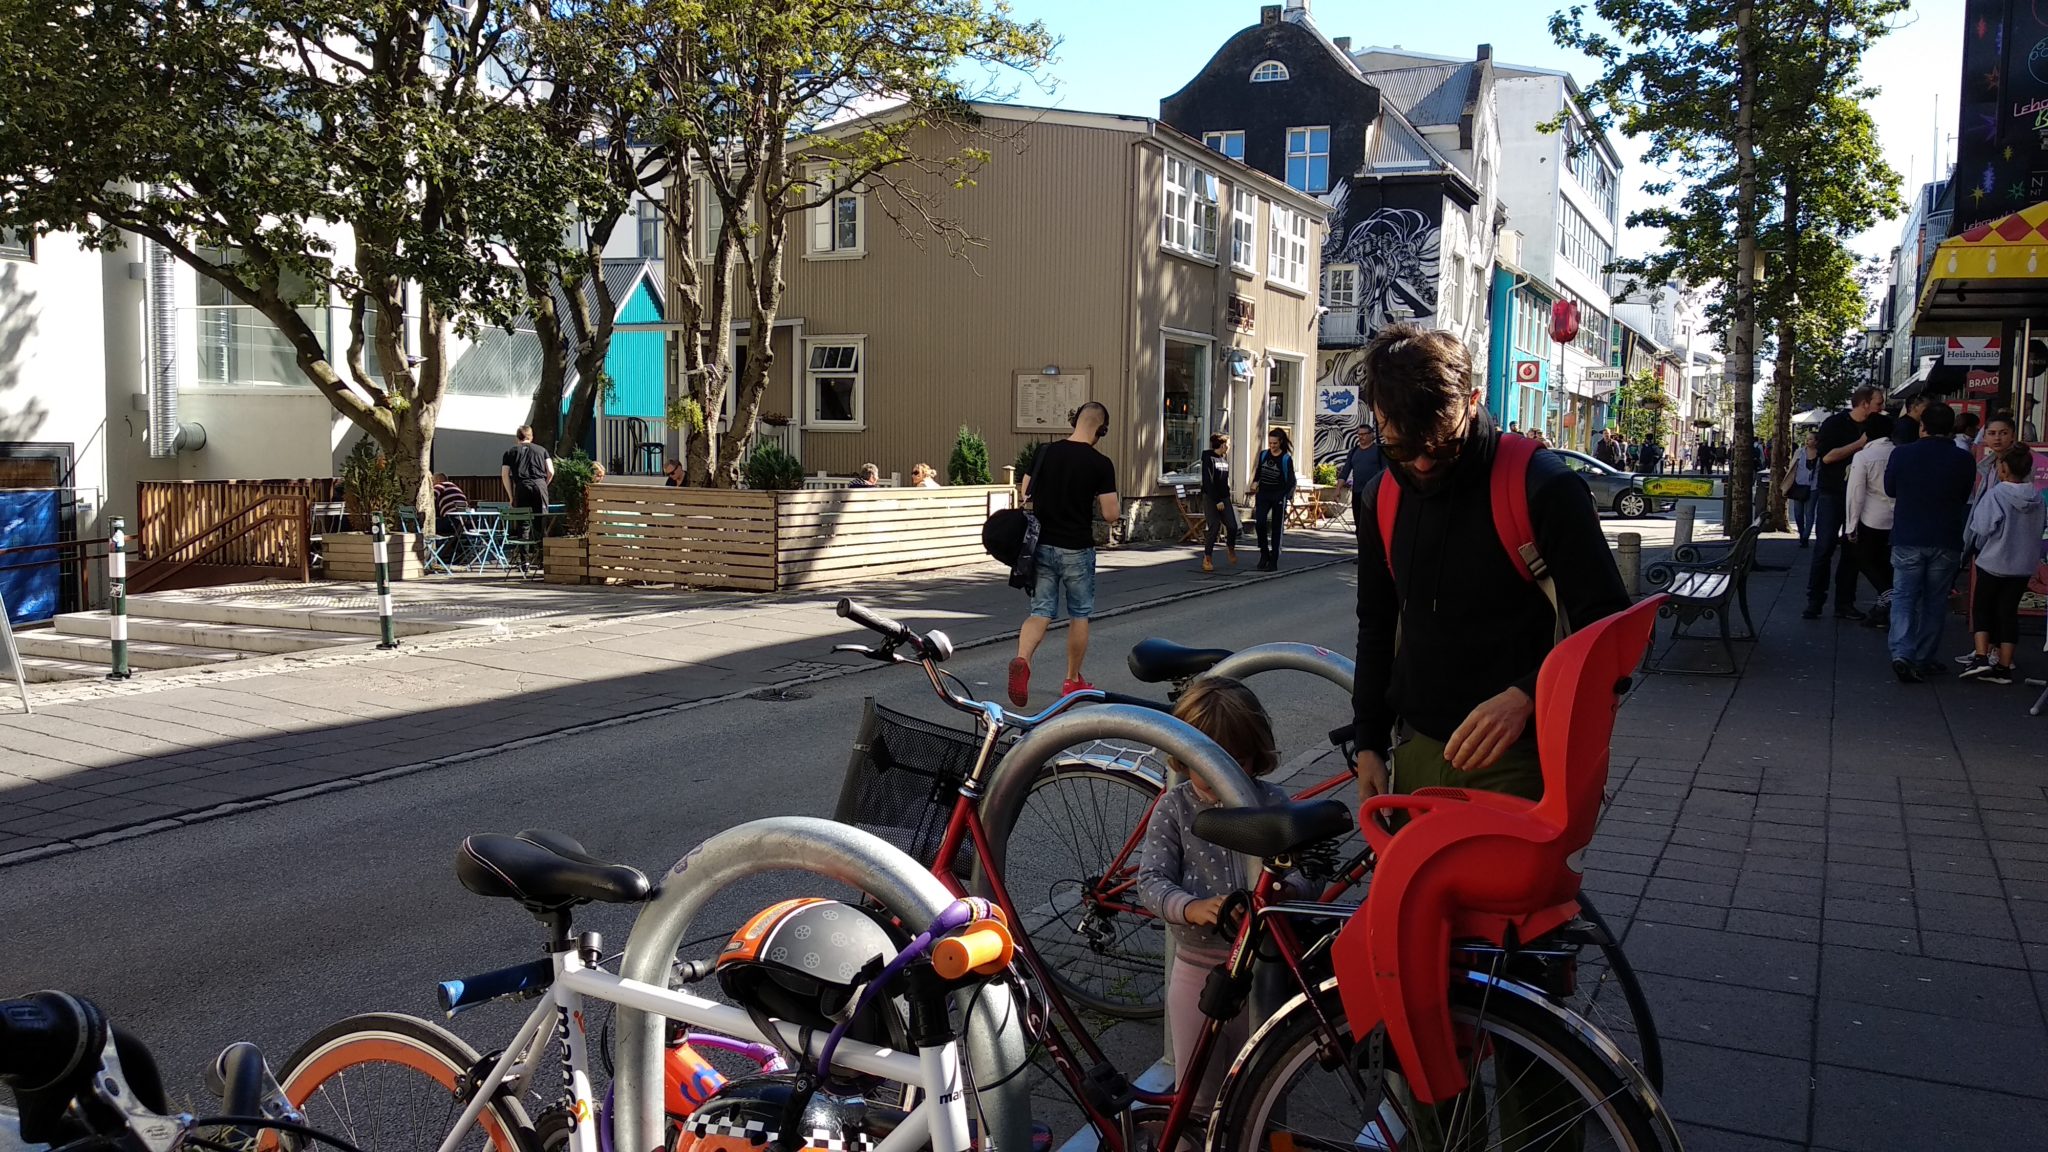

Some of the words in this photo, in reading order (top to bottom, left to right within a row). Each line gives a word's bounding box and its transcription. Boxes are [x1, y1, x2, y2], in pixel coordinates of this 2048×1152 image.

[1947, 350, 2000, 358] Heilsuhúsið
[1588, 370, 1619, 380] Papilla
[555, 1004, 578, 1134] mango
